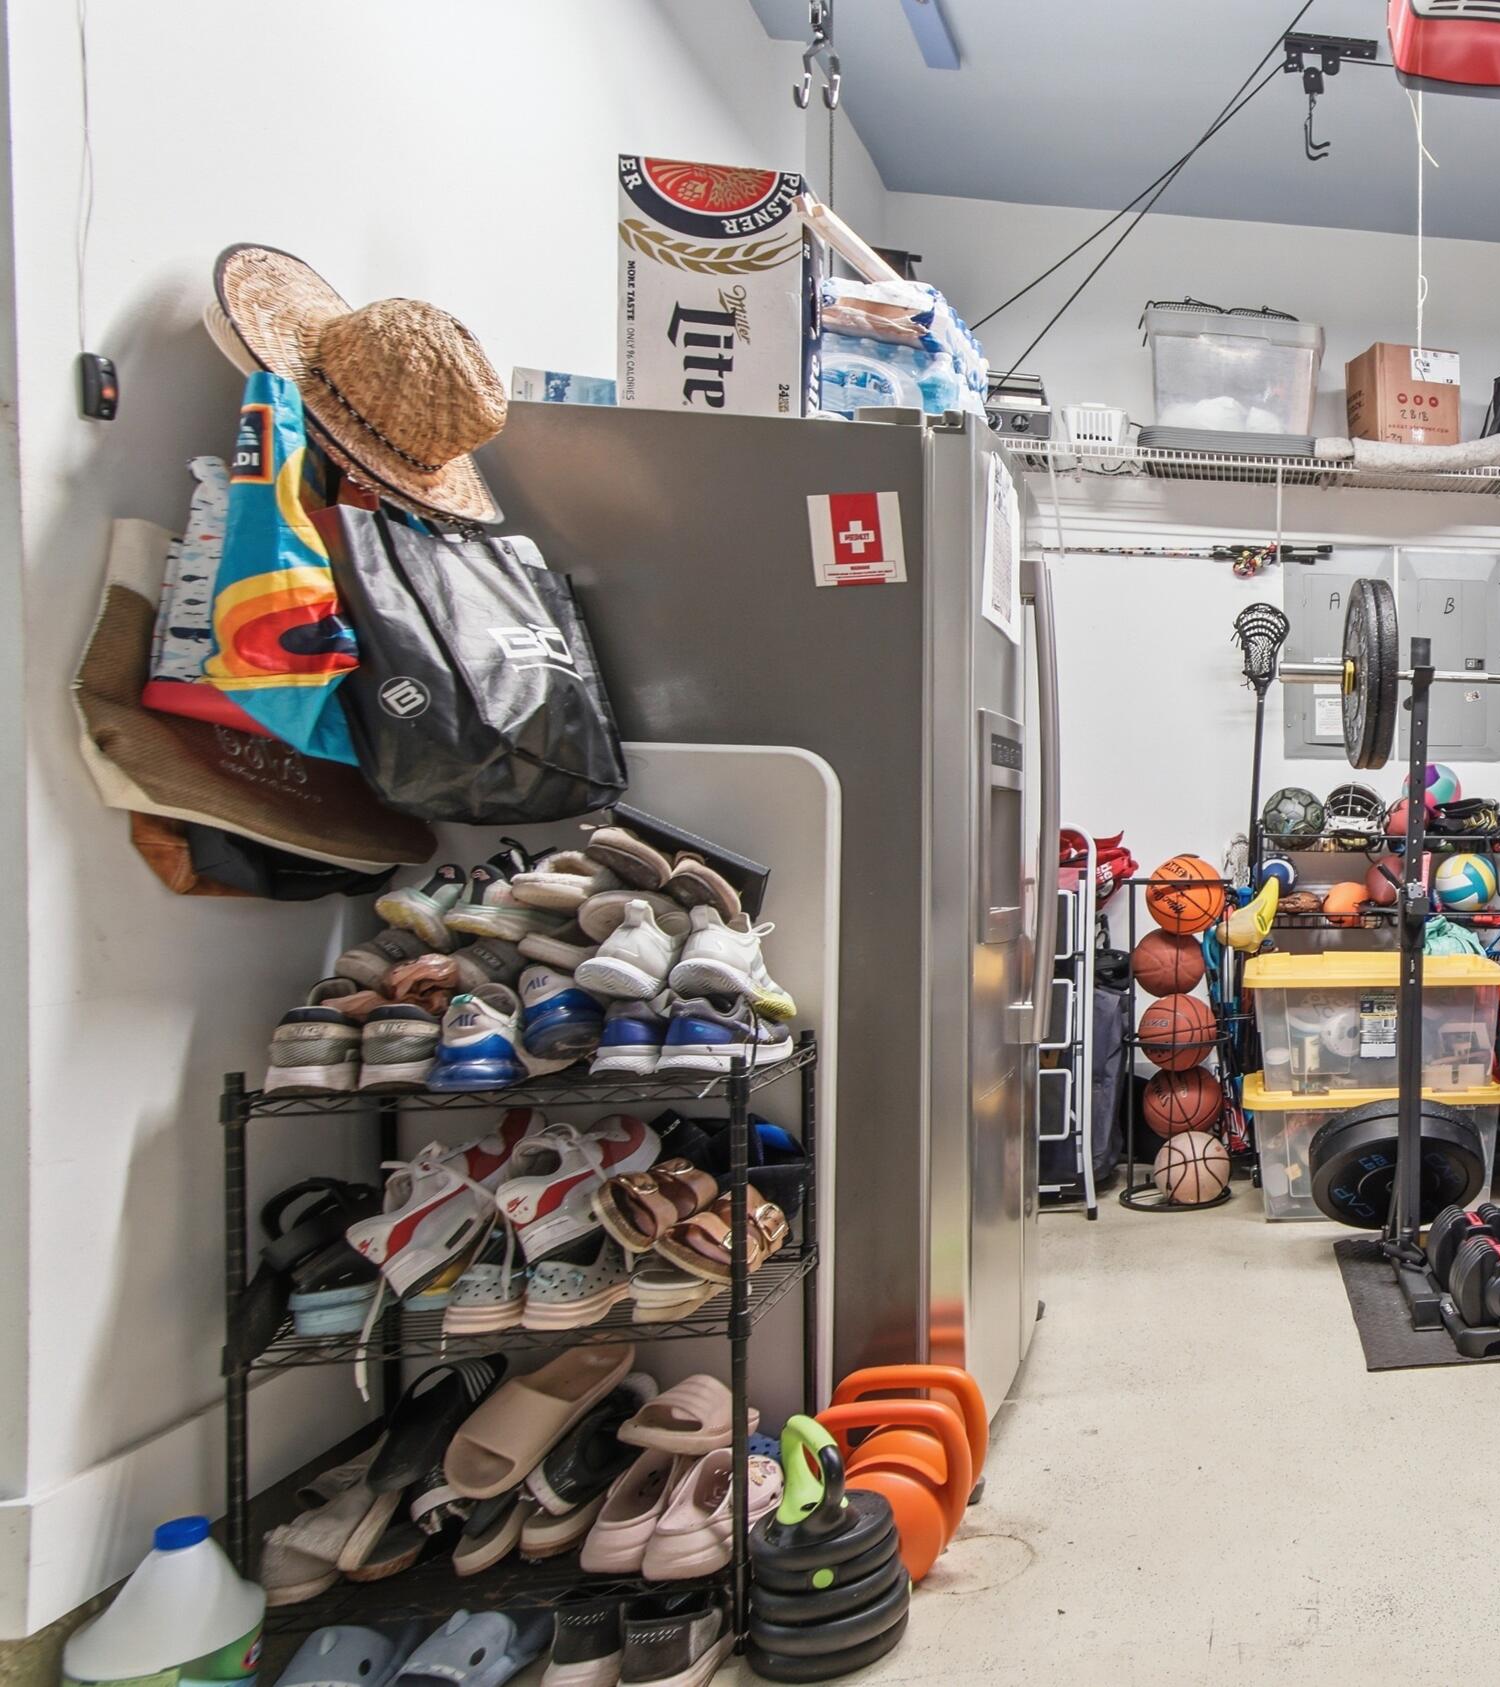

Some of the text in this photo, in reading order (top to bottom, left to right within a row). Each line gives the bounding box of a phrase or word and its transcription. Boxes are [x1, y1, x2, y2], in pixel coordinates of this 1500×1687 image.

[721, 173, 800, 234] PILSNER
[628, 260, 636, 290] MORE
[627, 290, 636, 321] TASTE
[718, 285, 750, 345] Miller
[626, 327, 635, 353] ONLY
[667, 300, 737, 409] Lite
[626, 362, 635, 401] CALORIES
[232, 452, 260, 467] DI
[1329, 591, 1341, 610] A
[1443, 597, 1455, 614] B
[378, 1023, 408, 1034] NIKE
